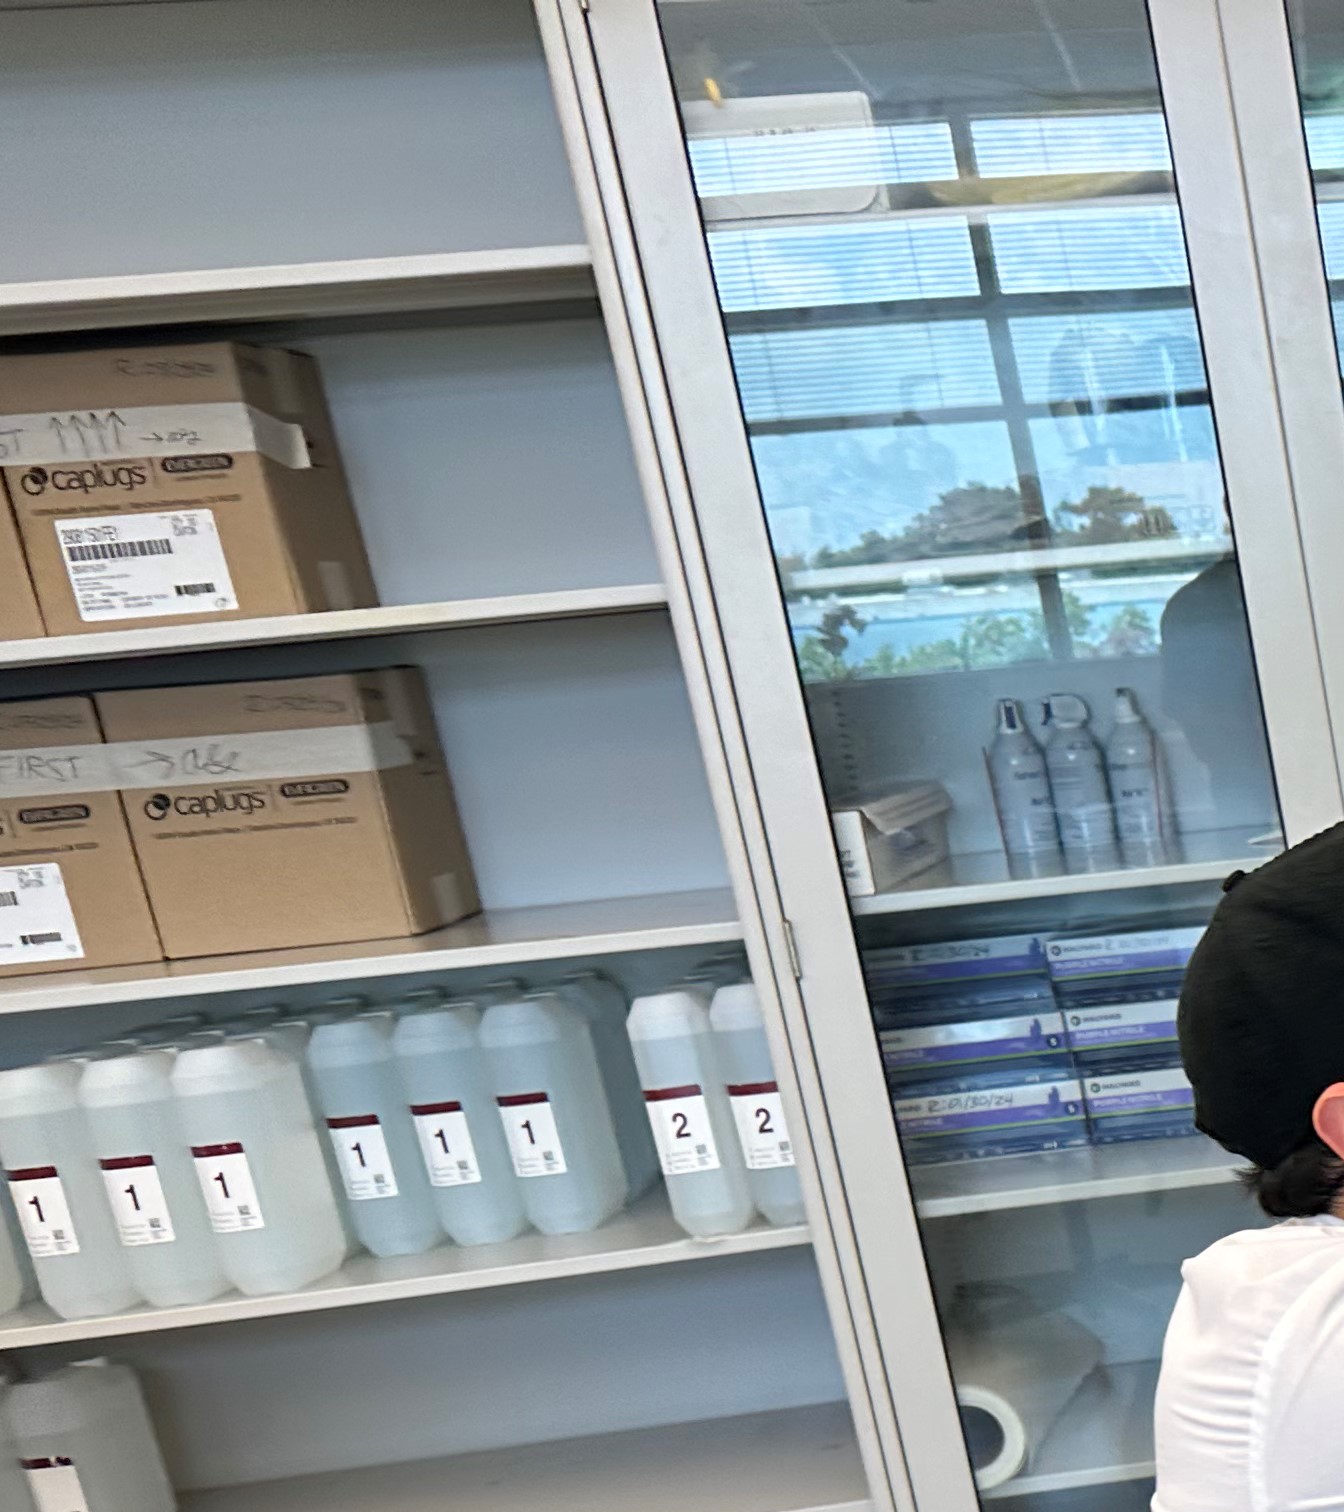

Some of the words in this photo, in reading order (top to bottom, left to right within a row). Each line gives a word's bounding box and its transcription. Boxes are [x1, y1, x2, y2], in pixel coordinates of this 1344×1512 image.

[52, 462, 147, 492] caplugs
[174, 788, 267, 817] caplugs
[521, 1120, 536, 1145] 1
[672, 1112, 691, 1139] 2
[755, 1107, 774, 1134] 2
[351, 1142, 366, 1167] 1
[434, 1129, 450, 1154] 1
[124, 1184, 140, 1211] 1
[214, 1172, 230, 1198] 1
[28, 1195, 45, 1222] 1
